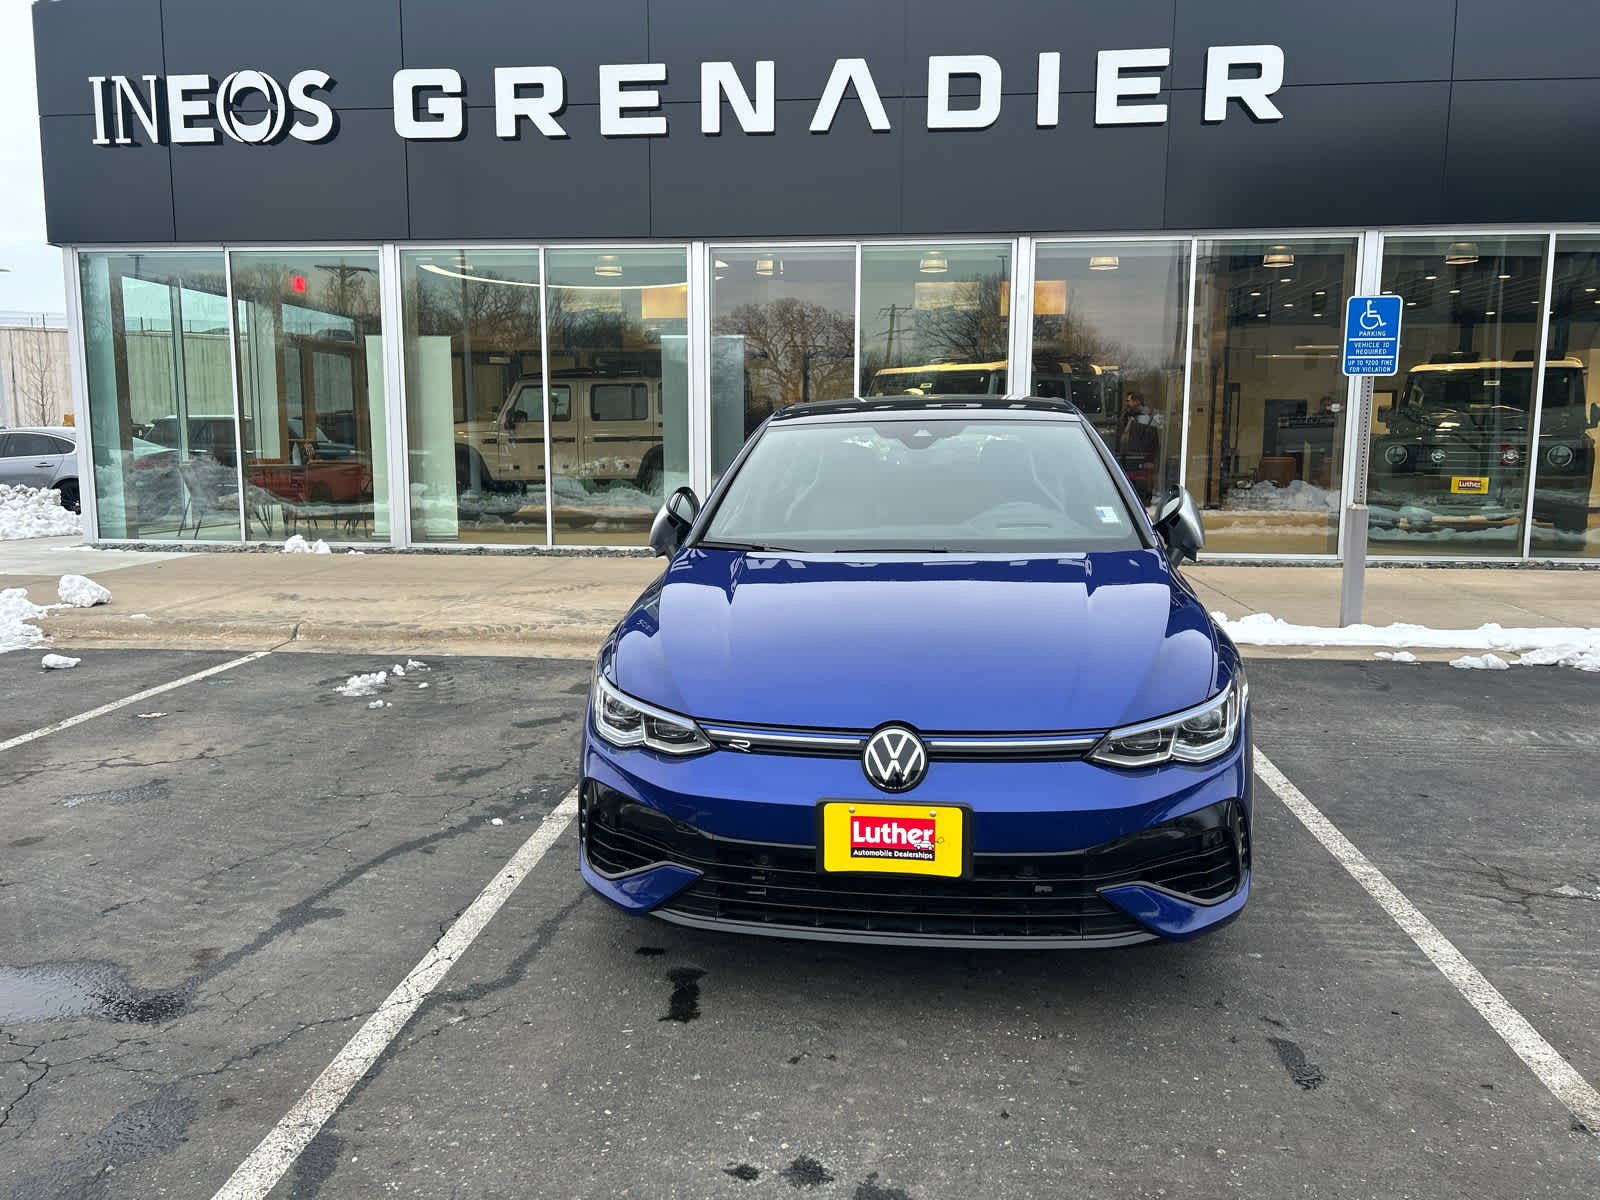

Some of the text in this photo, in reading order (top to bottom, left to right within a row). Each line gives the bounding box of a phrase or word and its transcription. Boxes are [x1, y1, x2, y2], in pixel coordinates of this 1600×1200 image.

[88, 44, 1285, 145] INEOS GRENADIER
[852, 821, 934, 845] Luther
[852, 849, 933, 859] Automobile Dealerships
